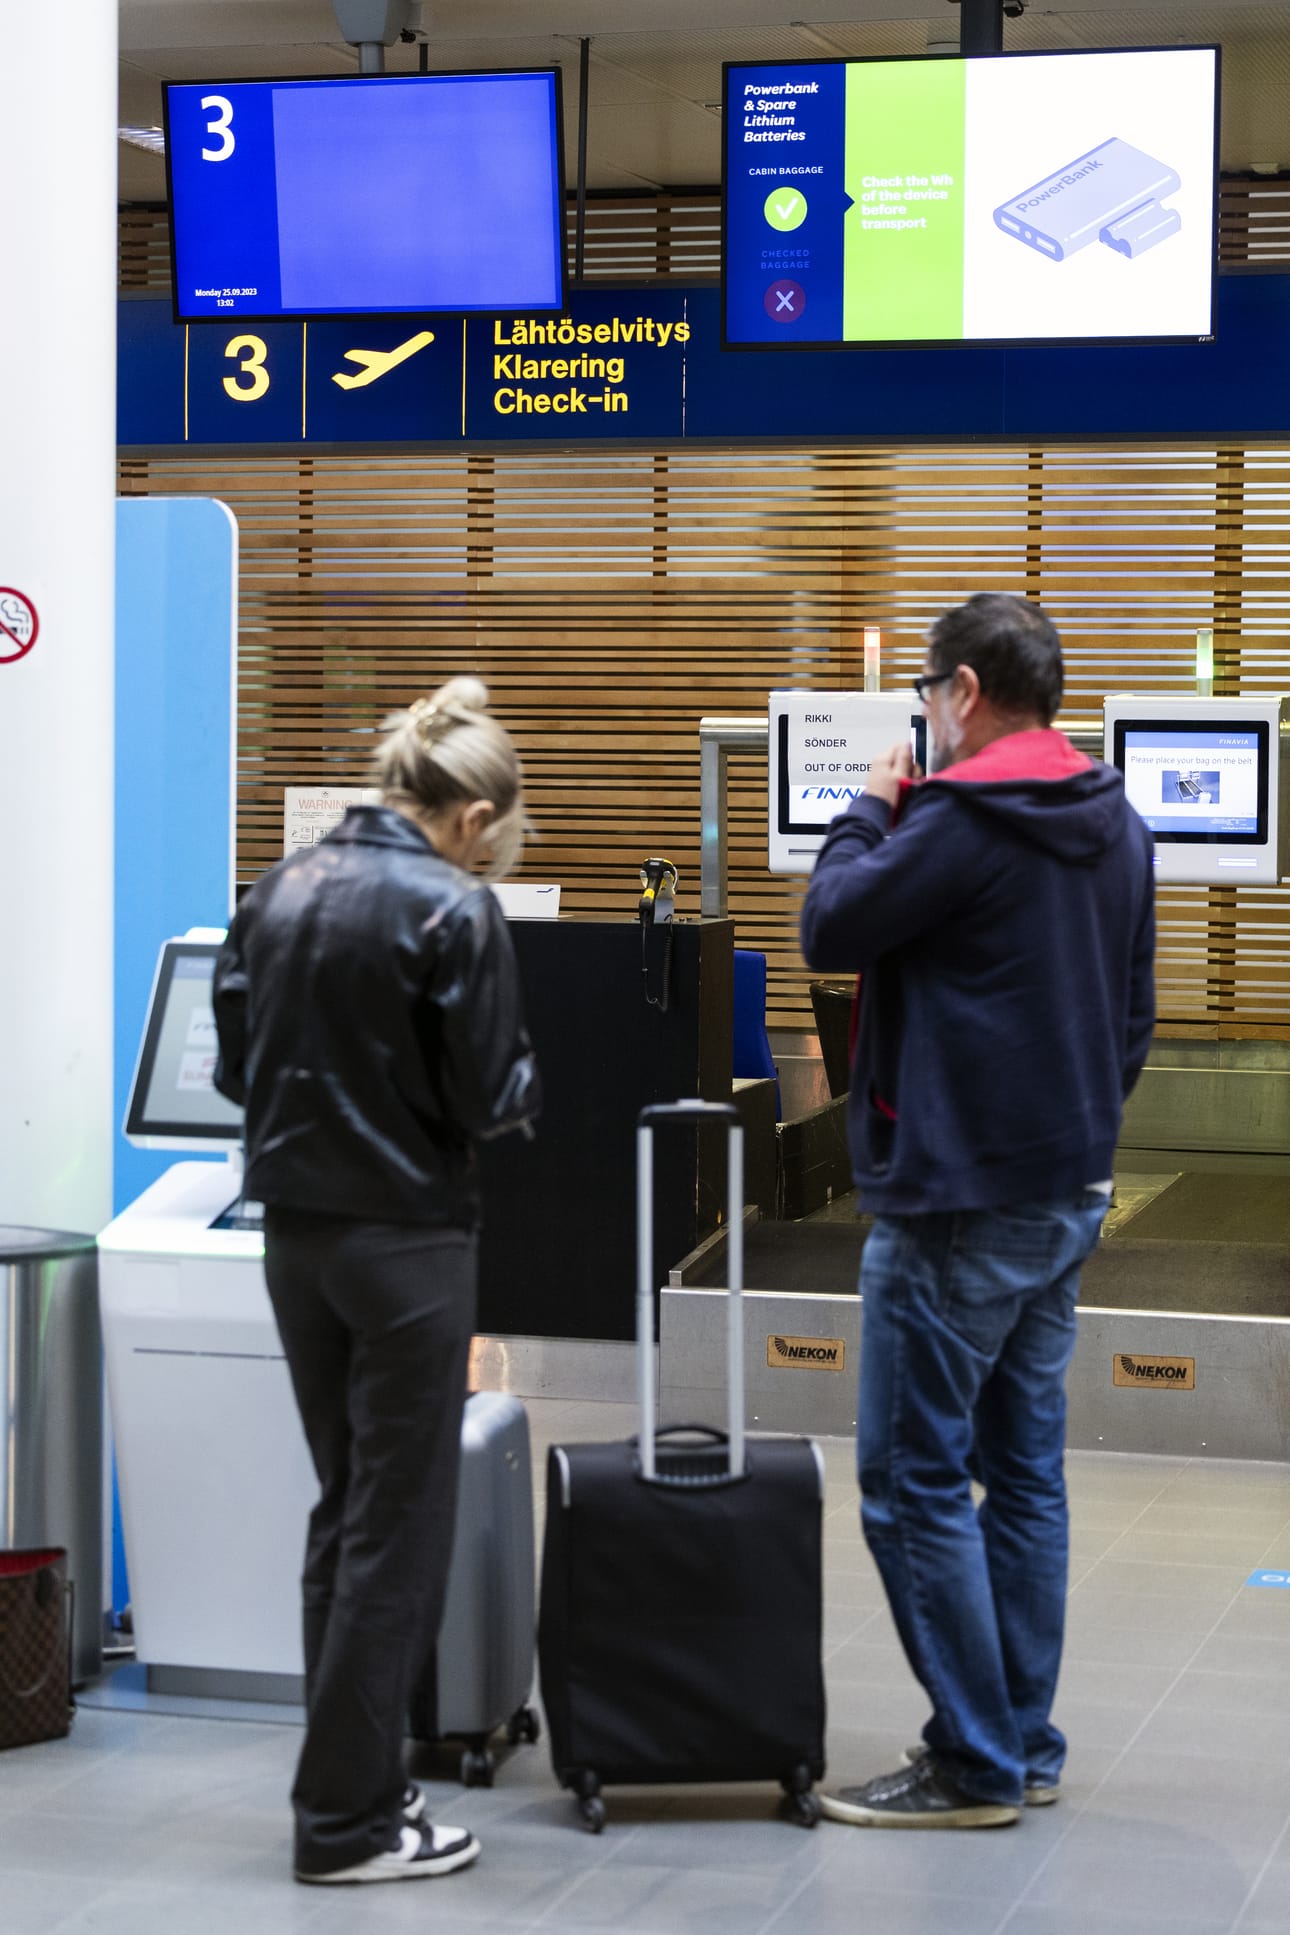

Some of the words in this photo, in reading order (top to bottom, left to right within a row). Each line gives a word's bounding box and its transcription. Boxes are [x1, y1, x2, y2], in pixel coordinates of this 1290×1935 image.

[744, 82, 819, 96] Powerbank
[744, 100, 755, 111] &
[756, 99, 797, 113] Spare
[744, 114, 796, 127] Lithium
[201, 95, 236, 162] 3
[744, 129, 806, 142] Batteries
[749, 167, 777, 175] CABIN
[779, 166, 824, 174] BAGGAGE
[862, 175, 903, 188] Check
[905, 174, 929, 186] the
[931, 173, 954, 185] Wh
[1016, 160, 1104, 213] PowerBank
[862, 189, 876, 201] of
[879, 189, 901, 200] the
[903, 187, 948, 200] device
[862, 203, 907, 215] before
[862, 217, 927, 230] transport
[761, 249, 810, 258] CHECKED
[760, 260, 811, 269] BAGGAGE
[195, 288, 221, 298] Monday
[222, 288, 257, 296] 25.09.2023
[217, 299, 234, 307] 13:02
[494, 317, 691, 347] Lähtöselvitys
[223, 335, 270, 402] 3
[494, 353, 625, 383] Klarering
[494, 387, 629, 414] Check-in
[805, 714, 832, 723] RIKKI
[805, 738, 847, 748] SÖNDER
[805, 763, 826, 772] OUT
[828, 763, 842, 772] OF
[1131, 756, 1154, 764] Please
[1156, 756, 1176, 766] place
[1177, 758, 1195, 767] your
[1196, 756, 1210, 767] bag
[1224, 757, 1236, 765] the
[1238, 757, 1252, 765] belt
[789, 1347, 837, 1360] NEKON
[1135, 1365, 1187, 1379] NEKON
